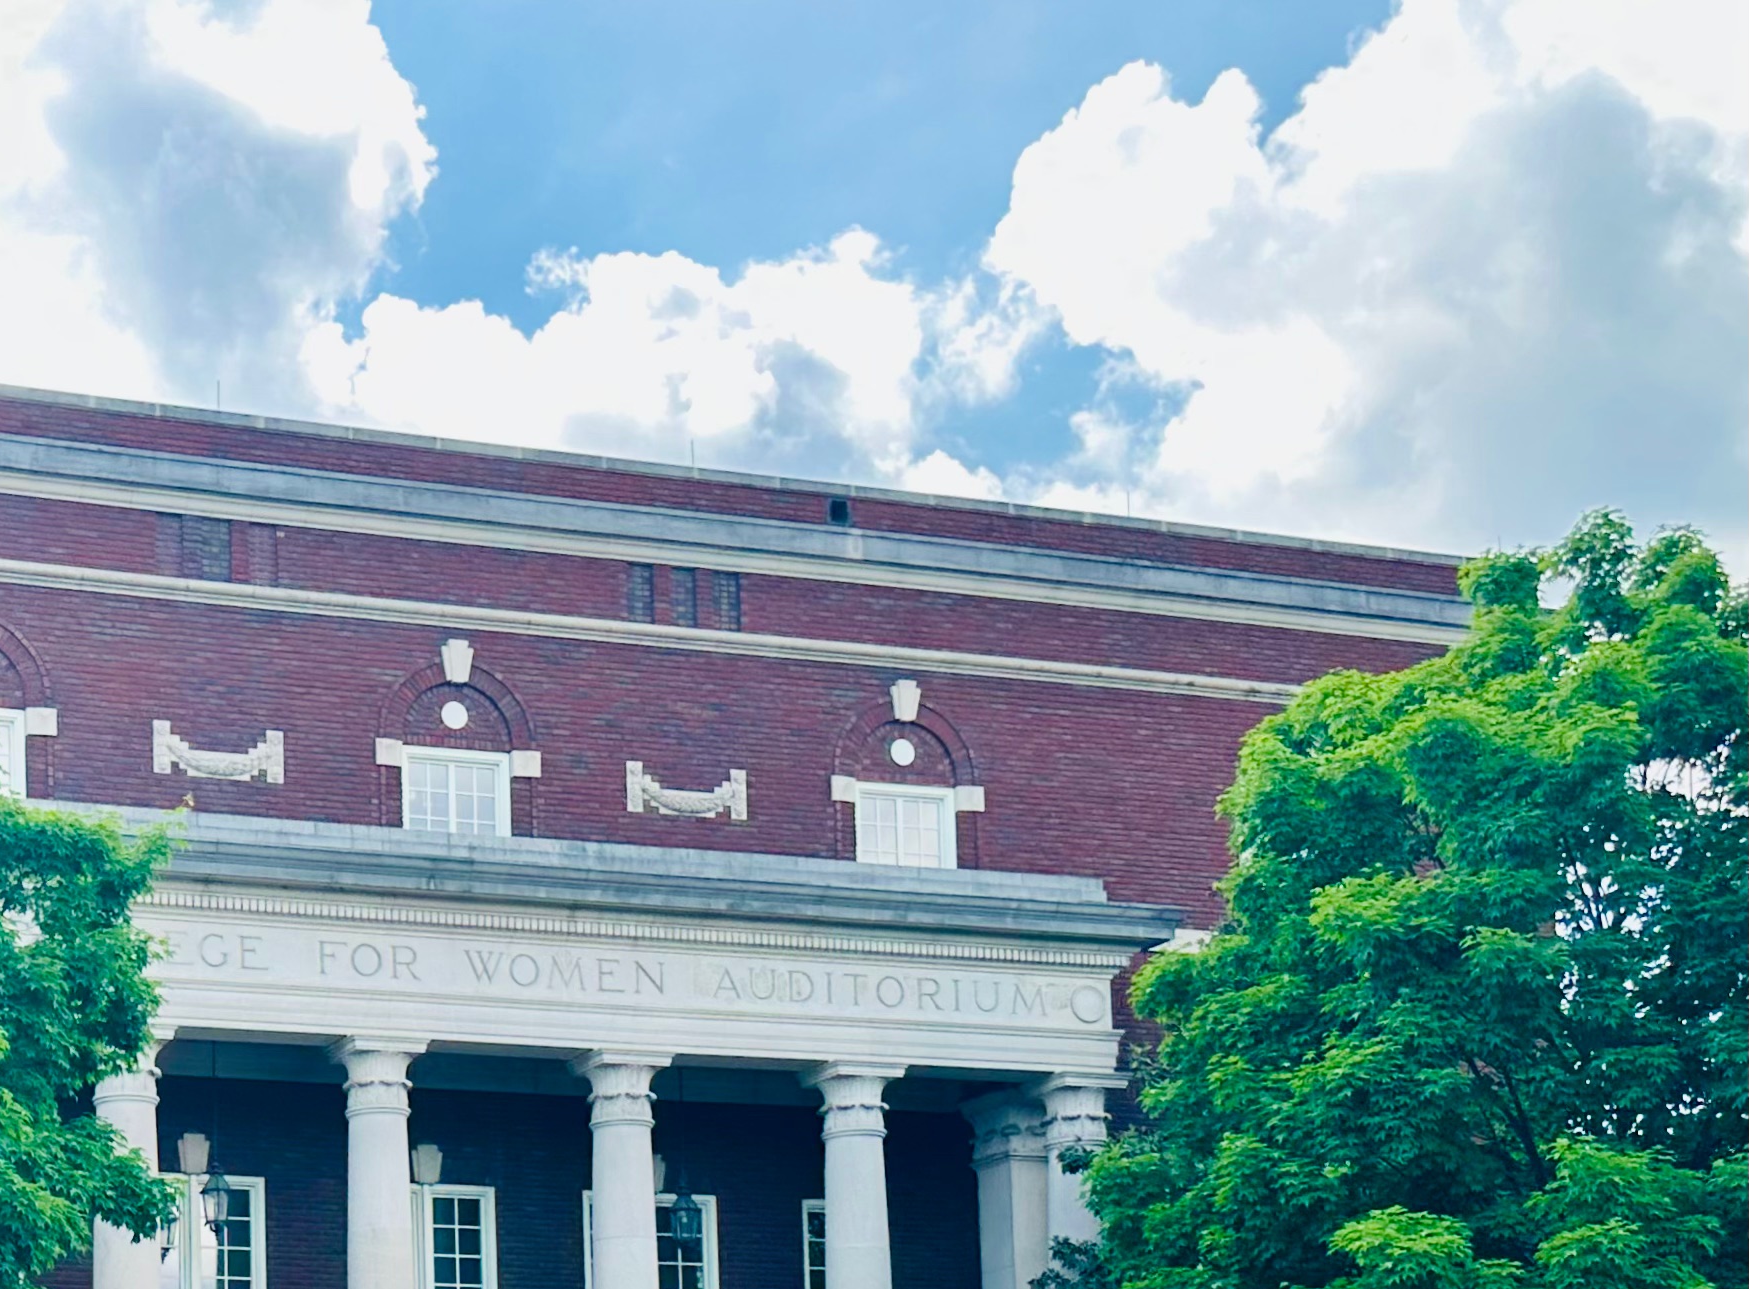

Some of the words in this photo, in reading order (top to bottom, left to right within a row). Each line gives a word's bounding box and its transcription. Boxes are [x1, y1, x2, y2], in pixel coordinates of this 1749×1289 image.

[318, 940, 422, 982] FOR
[463, 949, 666, 995] WOMEN
[712, 965, 1048, 1017] AUDITORIUM
